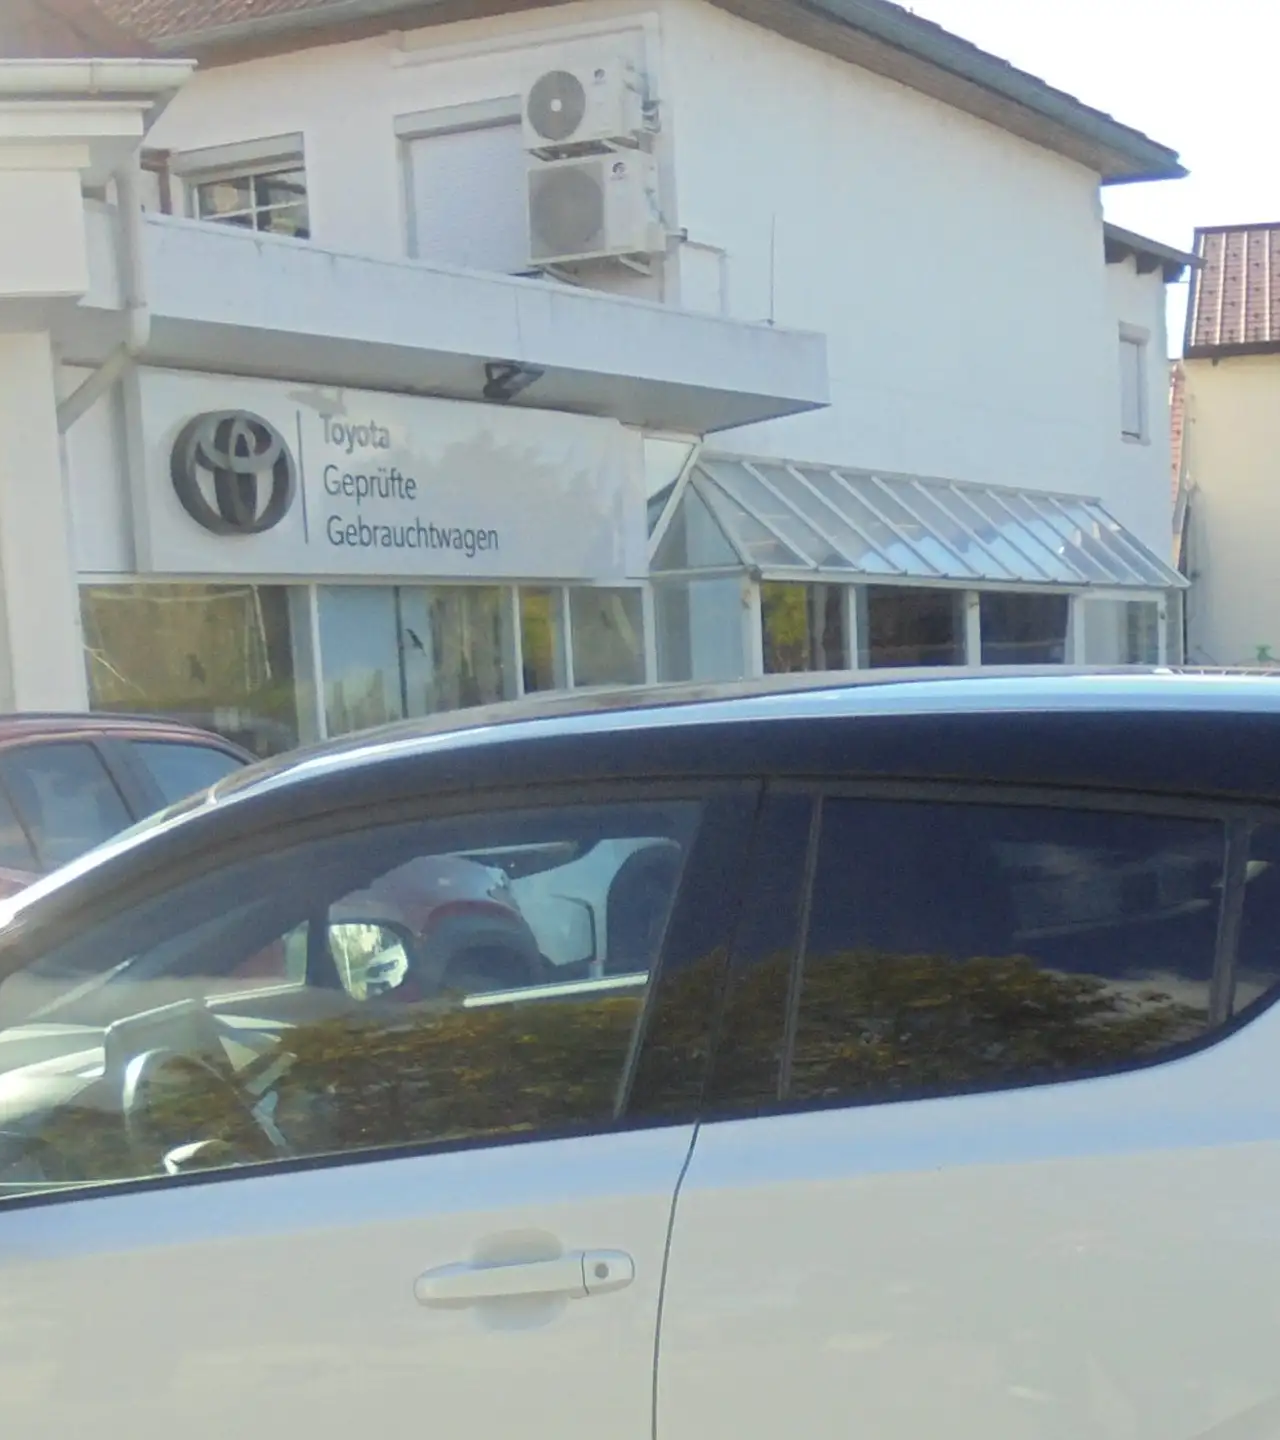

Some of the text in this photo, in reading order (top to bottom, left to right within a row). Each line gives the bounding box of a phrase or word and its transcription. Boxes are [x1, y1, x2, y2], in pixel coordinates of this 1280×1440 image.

[320, 414, 390, 454] Toyota
[323, 464, 417, 505] Geprüfte
[326, 515, 499, 558] Gebrauchtwagen
